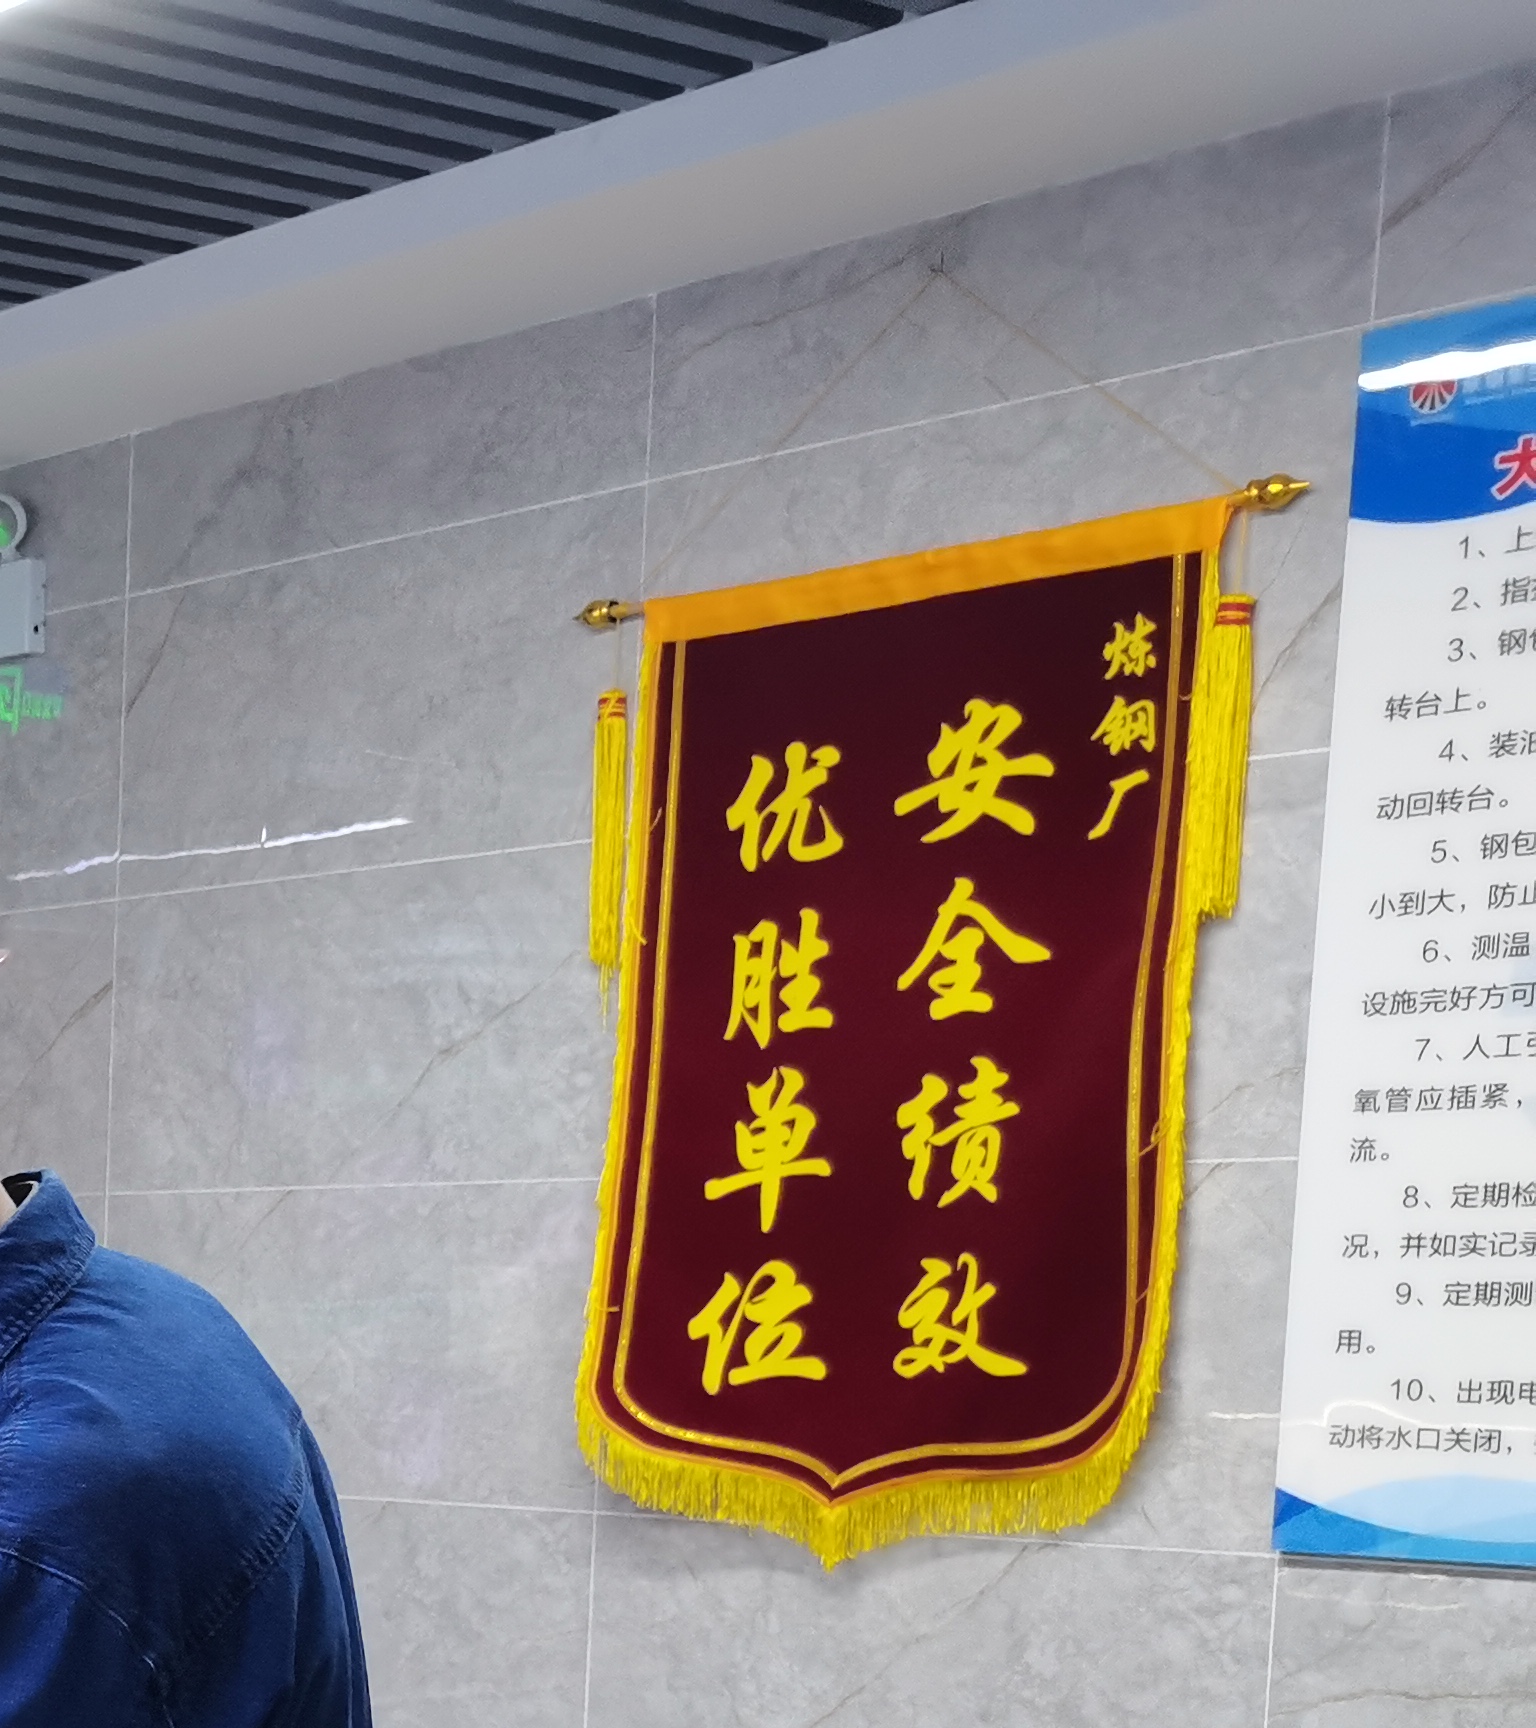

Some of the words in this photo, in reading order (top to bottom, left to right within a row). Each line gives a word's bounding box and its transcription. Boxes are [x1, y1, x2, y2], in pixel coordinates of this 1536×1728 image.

[1451, 576, 1536, 612] 2、指
[1447, 628, 1536, 663] 3、钢
[1384, 687, 1487, 722] 转台上。
[1088, 612, 1157, 840] 炼钢厂
[1376, 784, 1509, 820] 动回转台。
[1430, 829, 1536, 864] 5、钢包
[1422, 931, 1531, 963] 6、测温
[1362, 982, 1536, 1018] 设施完好方可
[892, 698, 1055, 1380] 安全绩效
[688, 740, 844, 1396] 优胜单位
[1353, 1082, 1523, 1115] 氧管应插紧，
[1349, 1135, 1390, 1163] 流。
[1402, 1181, 1536, 1209] 8、定期检
[1335, 1329, 1375, 1355] 用。
